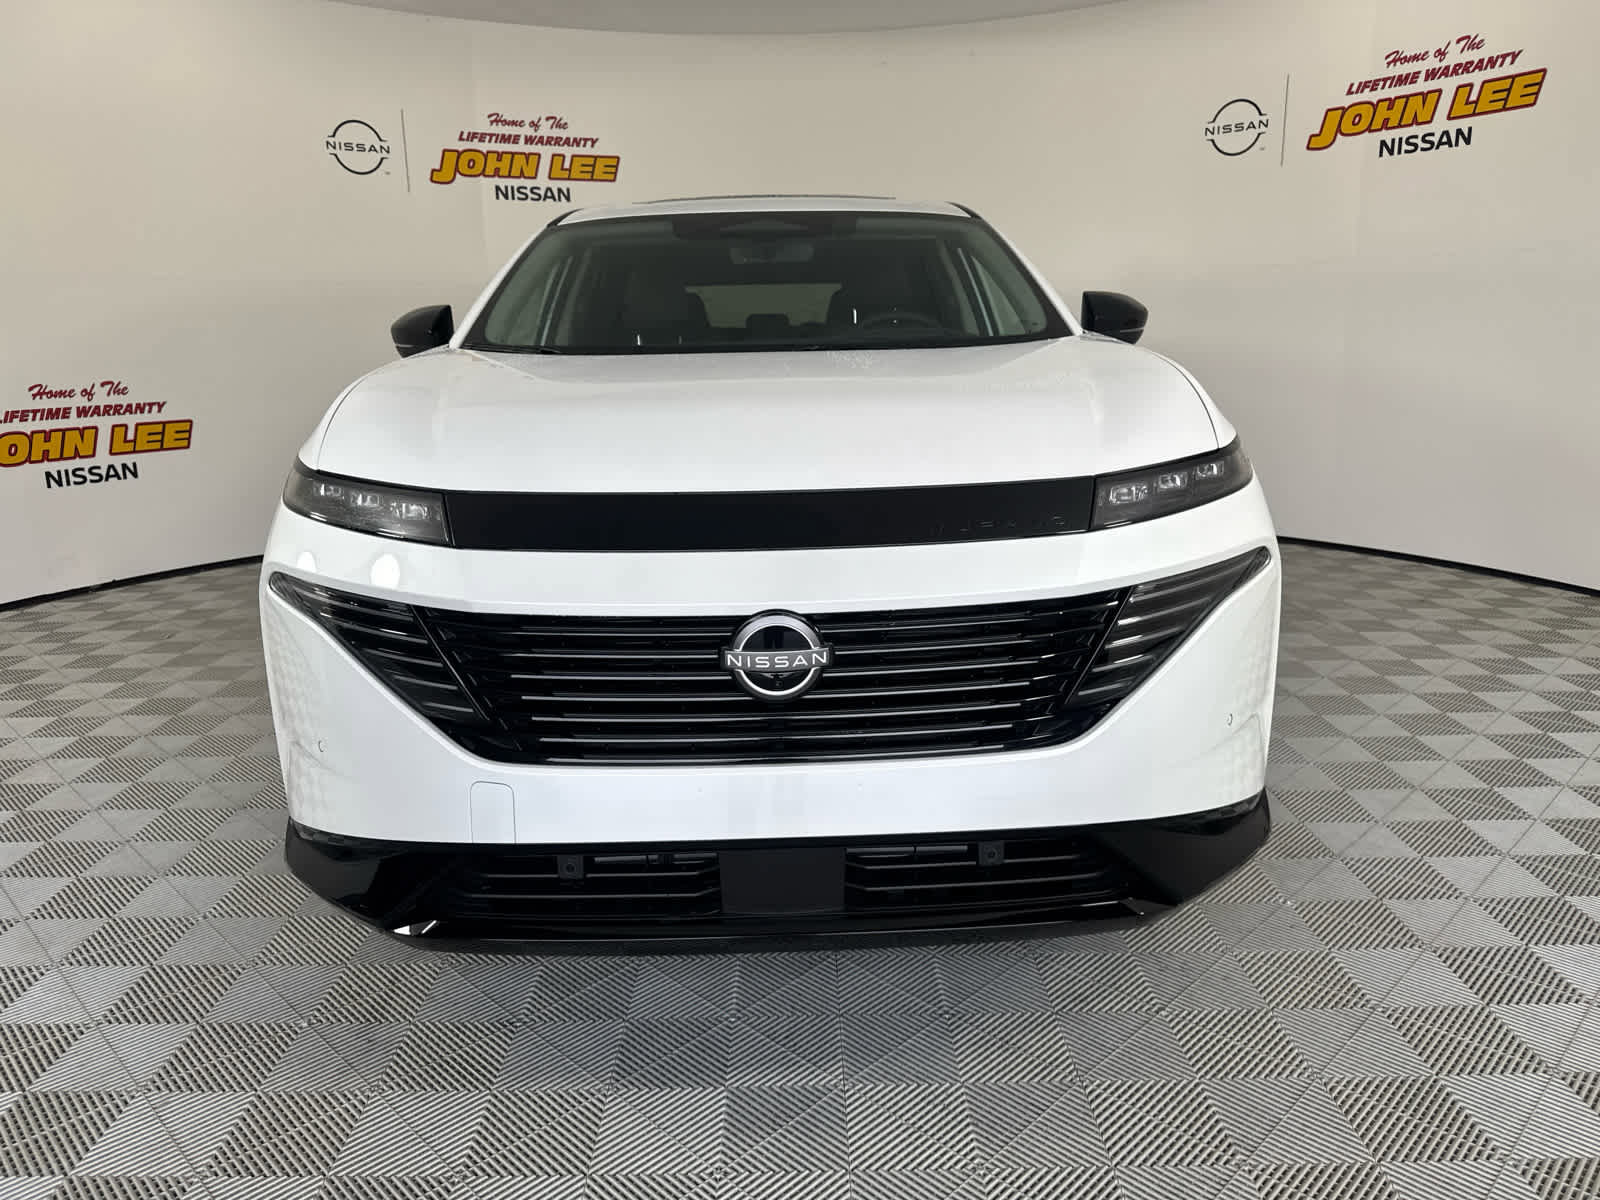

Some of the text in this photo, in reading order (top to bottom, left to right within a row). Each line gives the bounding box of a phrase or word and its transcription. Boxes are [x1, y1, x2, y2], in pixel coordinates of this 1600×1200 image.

[1384, 33, 1485, 69] Home of The
[1345, 50, 1523, 96] LIFETIME WARRANTY
[1306, 68, 1547, 151] JOHN LEE
[488, 113, 569, 131] Home of The
[1204, 118, 1270, 136] NISSAN
[325, 140, 391, 154] NISSAN
[458, 131, 599, 148] LIFETIME WARRANTY
[1378, 126, 1473, 158] NISSAN
[430, 149, 620, 184] JOHN LEE
[495, 184, 571, 202] NISSAN
[28, 380, 129, 401] Home of The
[76, 401, 167, 418] WARRANTY
[0, 419, 193, 467] OHN LEE
[44, 462, 139, 488] NISSAN
[727, 651, 827, 668] NISSAN
